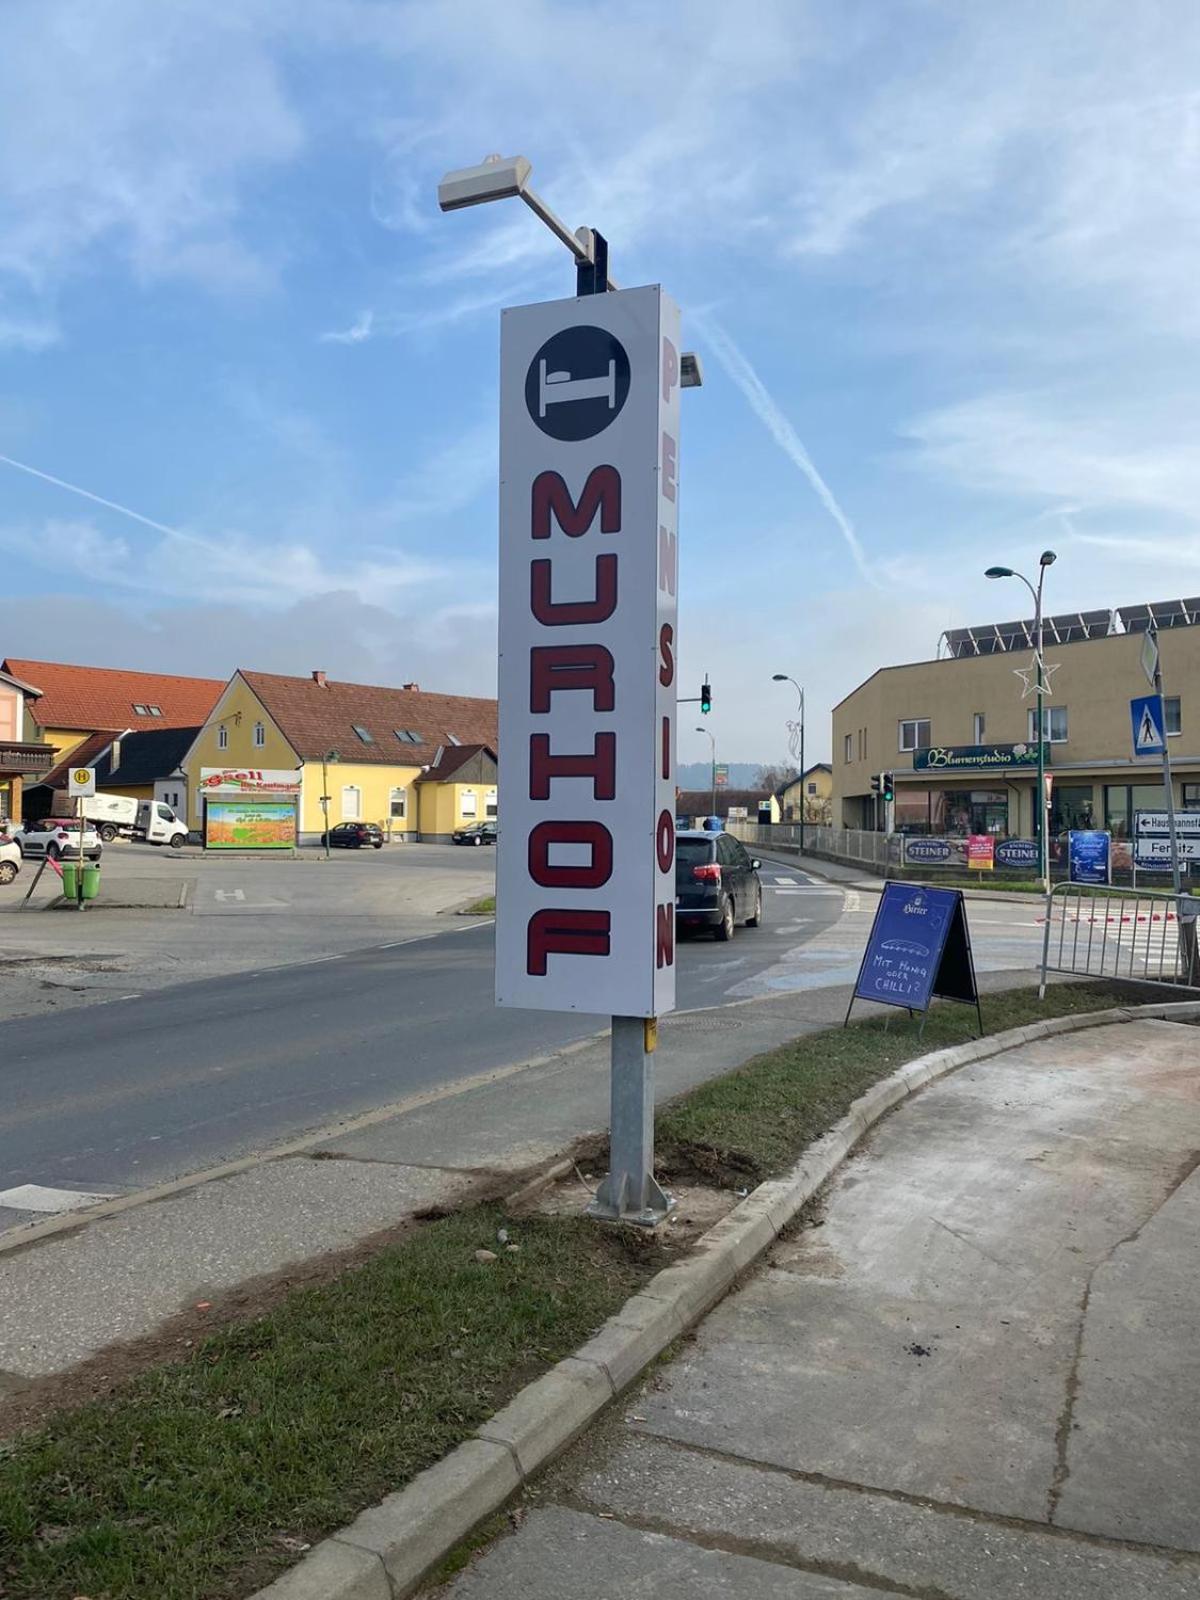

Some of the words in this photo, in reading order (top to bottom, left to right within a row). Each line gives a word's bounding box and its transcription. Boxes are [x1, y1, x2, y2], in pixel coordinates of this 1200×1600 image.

[656, 335, 679, 970] PENSION
[527, 463, 622, 977] MURHOF
[926, 747, 1012, 769] Blumenstudio
[908, 847, 949, 857] STEINER
[1151, 842, 1194, 853] Feritz
